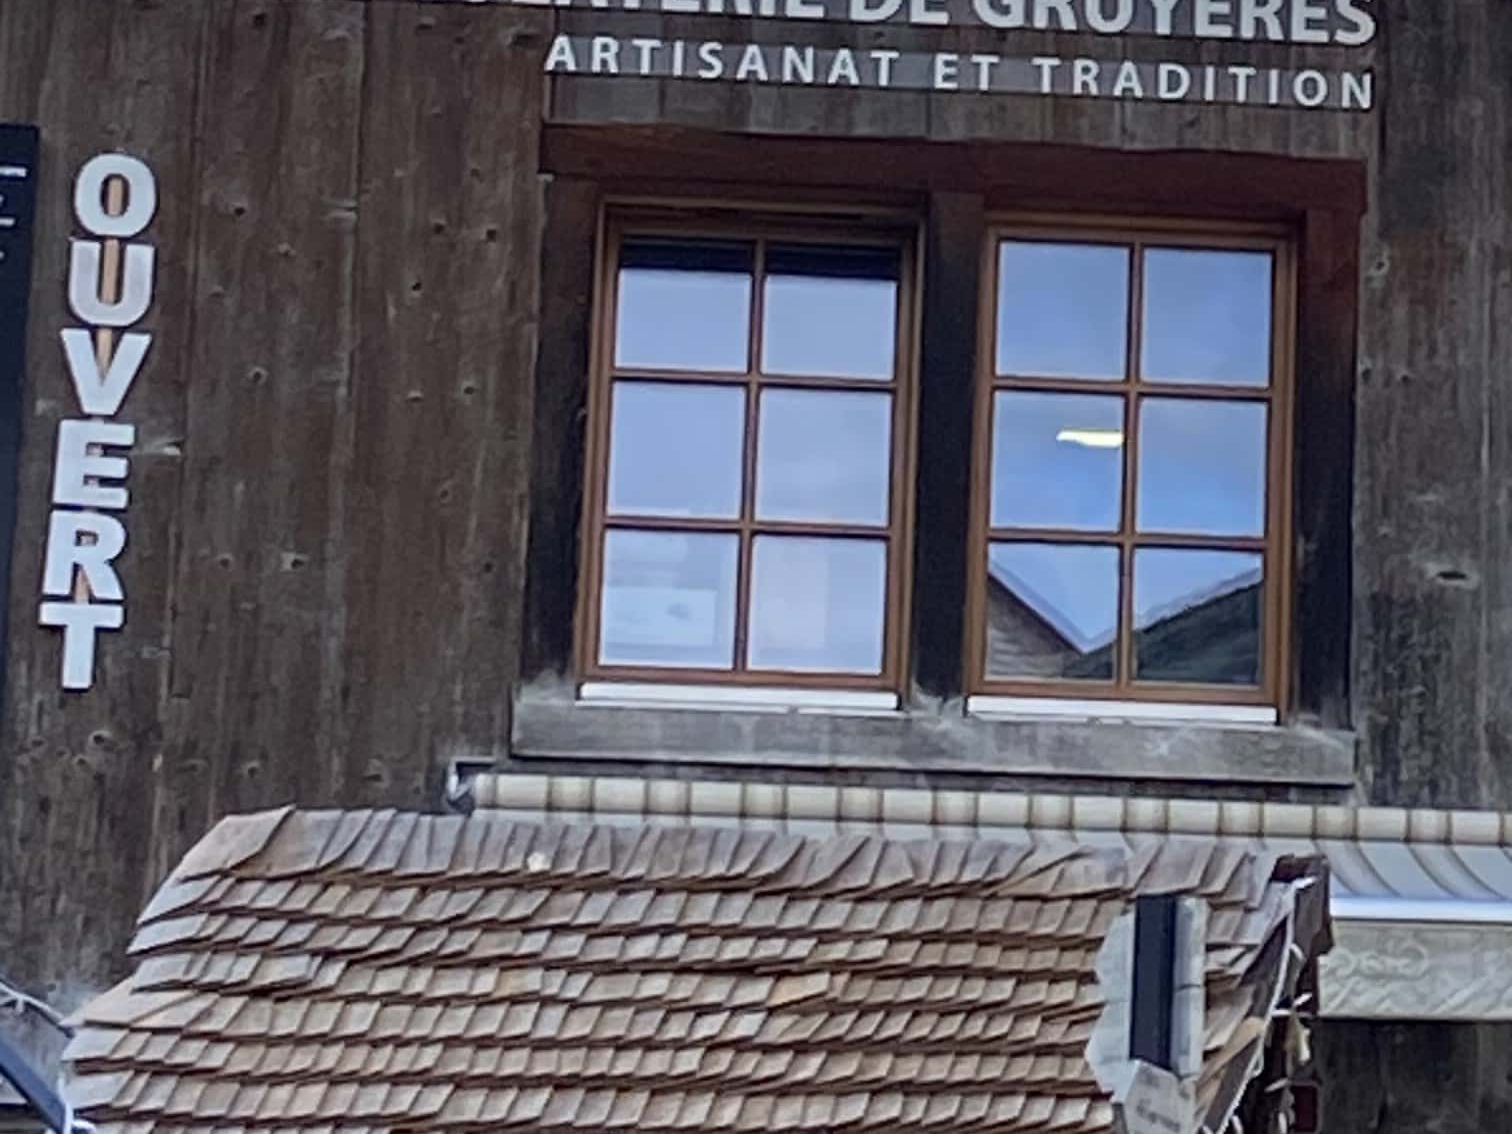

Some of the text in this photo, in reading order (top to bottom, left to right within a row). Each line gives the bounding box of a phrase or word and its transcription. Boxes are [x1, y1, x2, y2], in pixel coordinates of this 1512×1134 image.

[544, 34, 1373, 110] ARTISANAT ET TRADITION
[39, 152, 158, 690] OUVERT
